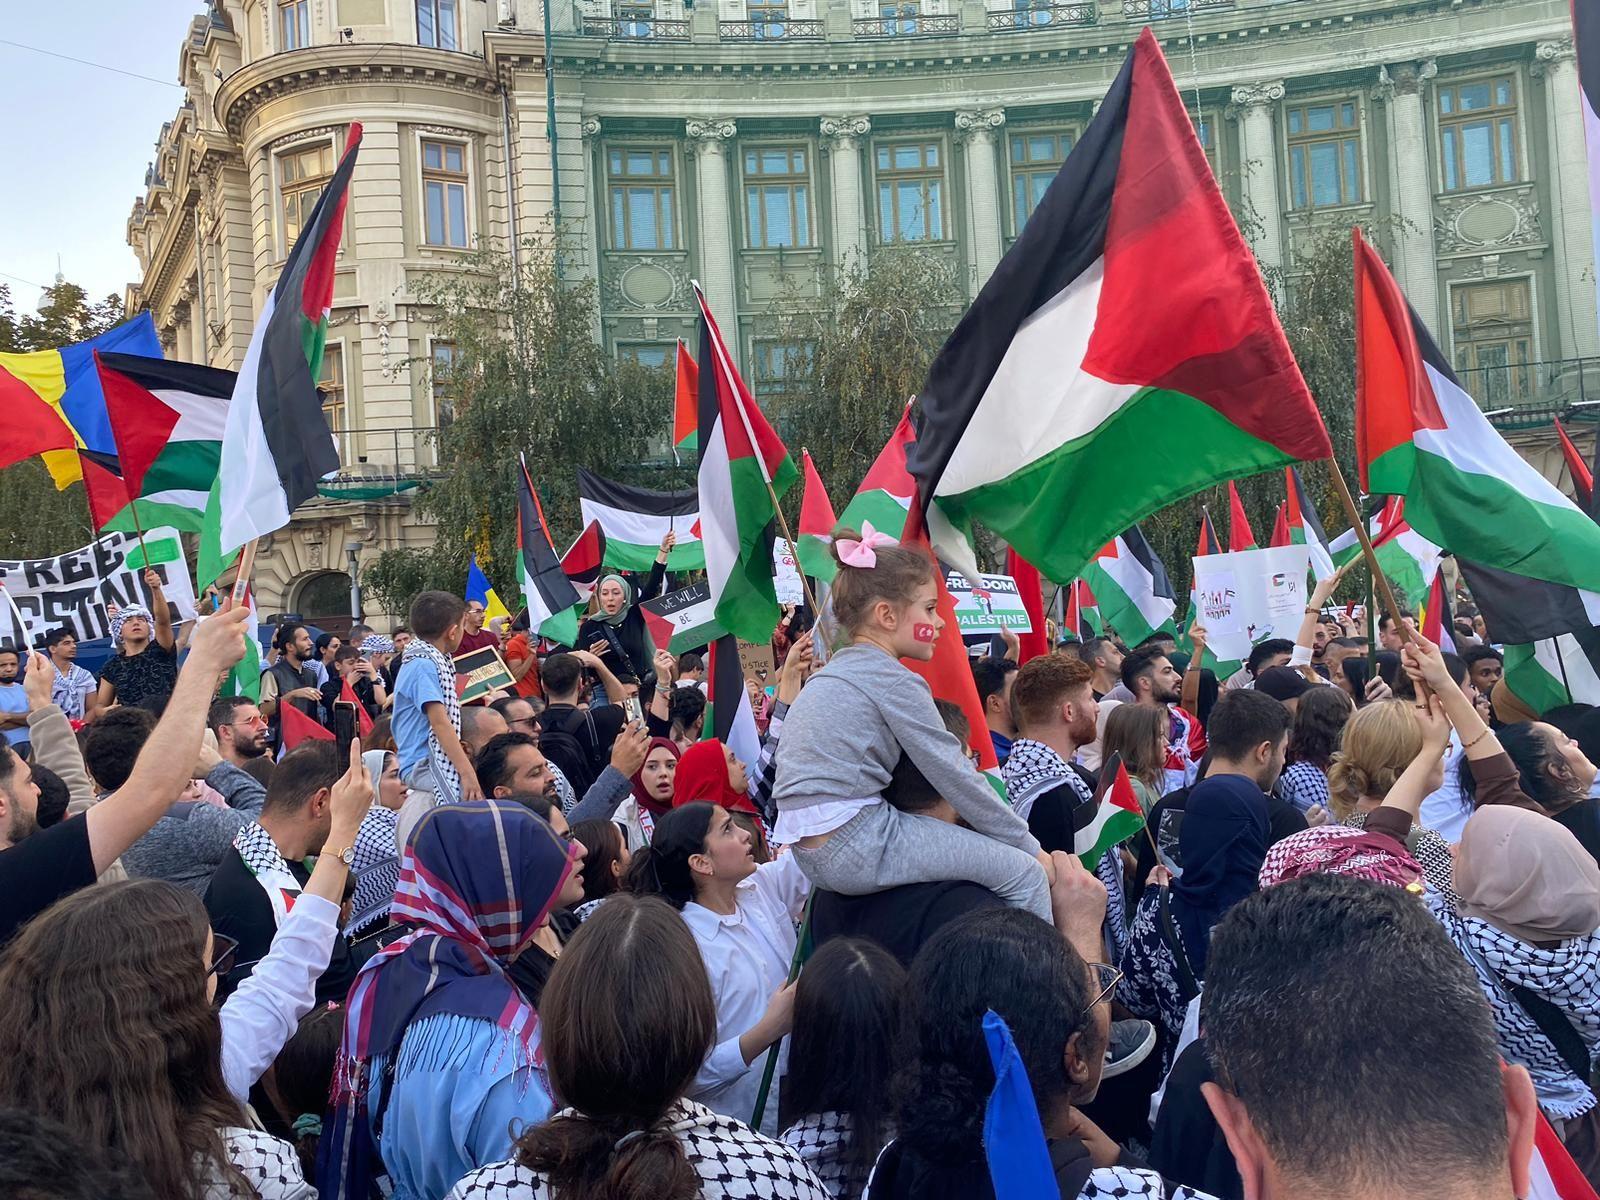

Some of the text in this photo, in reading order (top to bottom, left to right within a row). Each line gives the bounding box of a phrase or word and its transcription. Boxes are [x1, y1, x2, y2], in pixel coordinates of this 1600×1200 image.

[946, 576, 1015, 592] FREDOM
[660, 587, 703, 610] WE WILL
[679, 612, 692, 625] BE
[742, 660, 769, 670] USTICE
